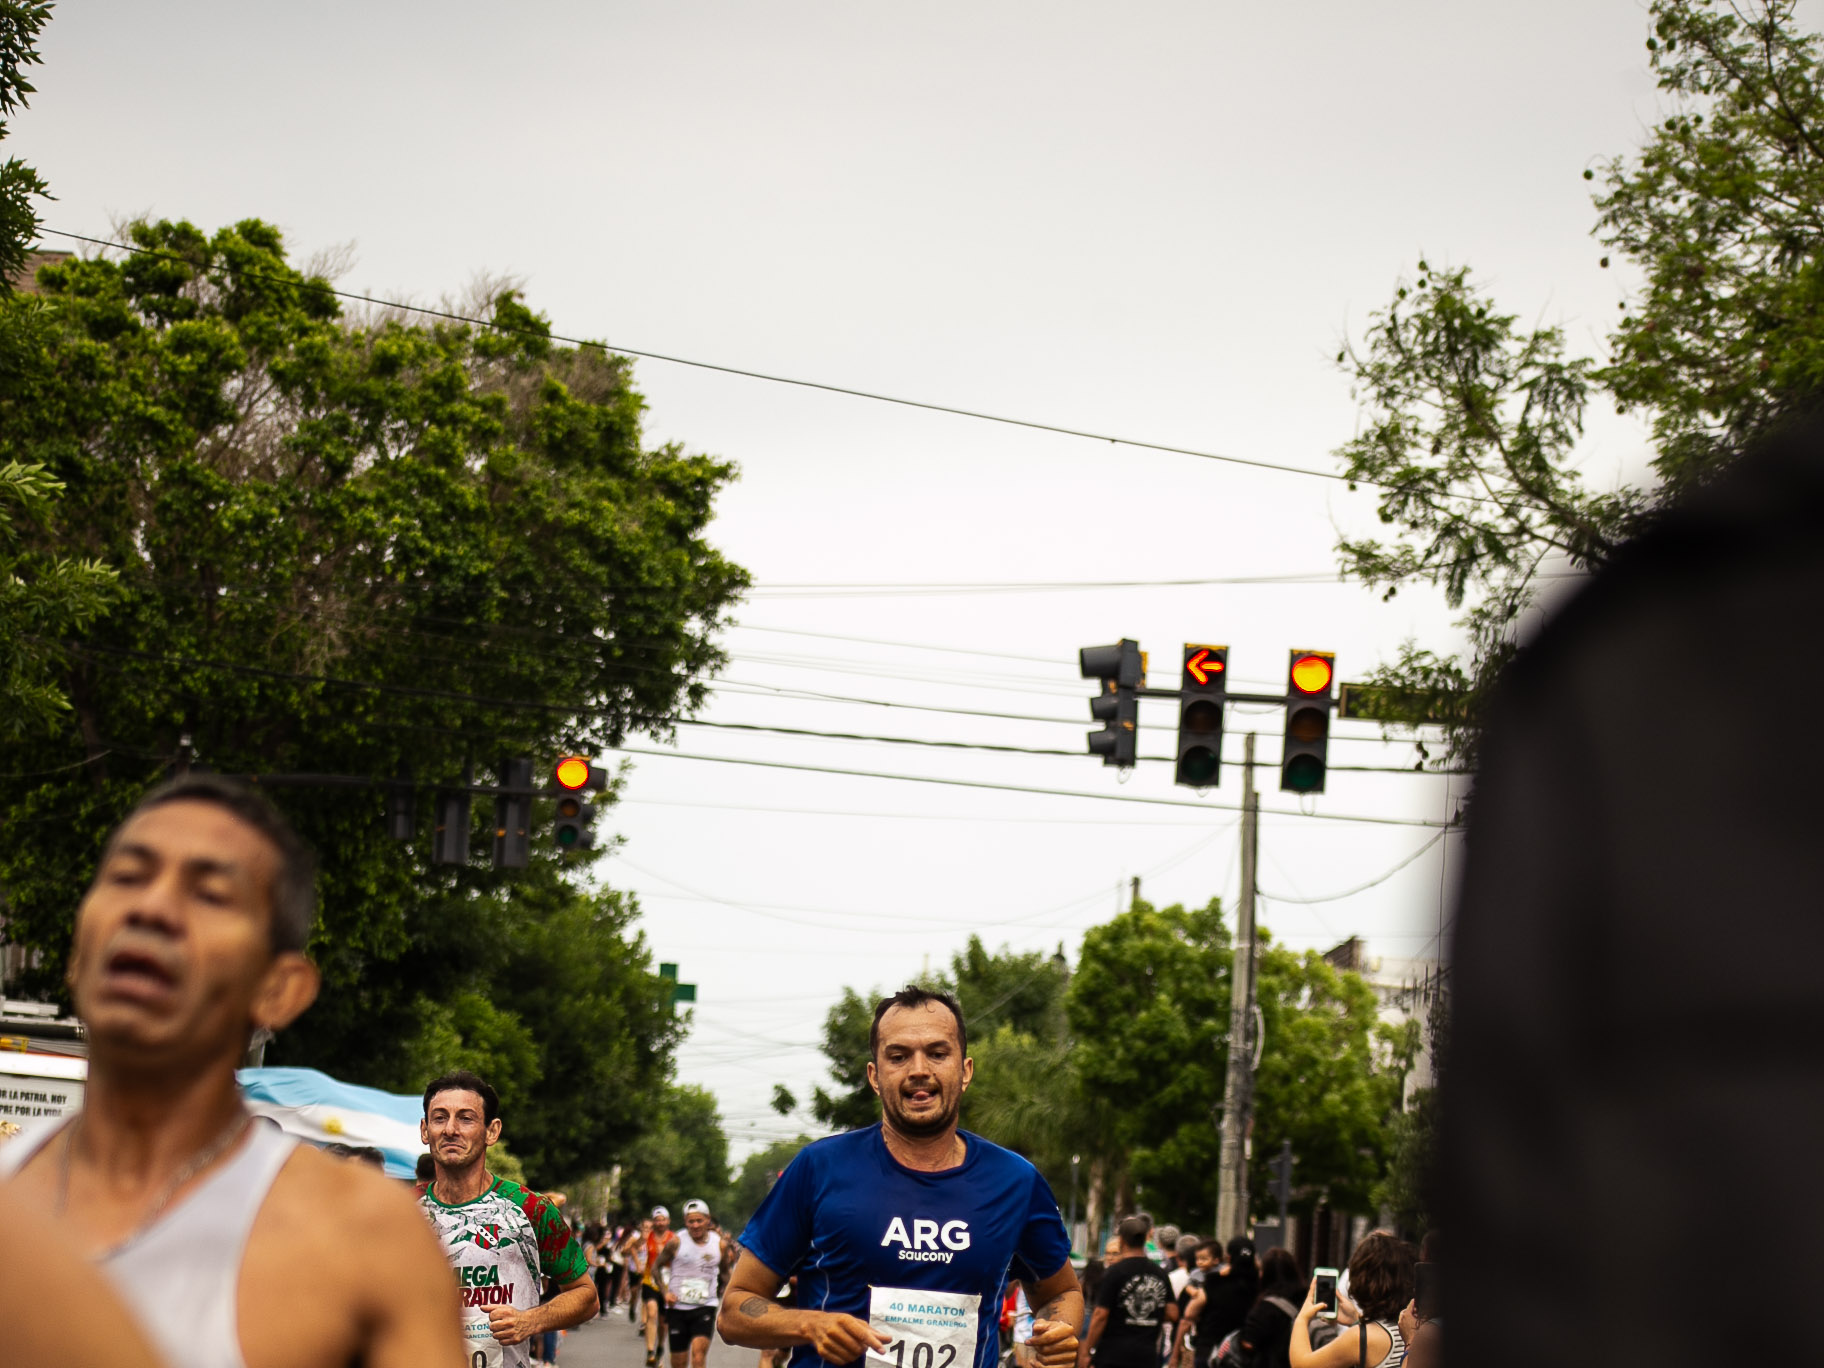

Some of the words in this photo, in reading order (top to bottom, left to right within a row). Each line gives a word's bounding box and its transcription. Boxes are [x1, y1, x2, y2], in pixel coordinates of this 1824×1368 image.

[9, 1089, 19, 1100] LA
[0, 1104, 13, 1115] PRE
[15, 1105, 31, 1117] POR
[33, 1107, 41, 1117] LA
[880, 1216, 971, 1251] ARG
[898, 1249, 954, 1264] saucony
[459, 1282, 515, 1307] RATON
[889, 1302, 904, 1312] 40
[907, 1303, 966, 1317] MARATON
[464, 1322, 490, 1332] ATON
[885, 1315, 924, 1325] EMPALME
[926, 1318, 968, 1329] GRANEROS
